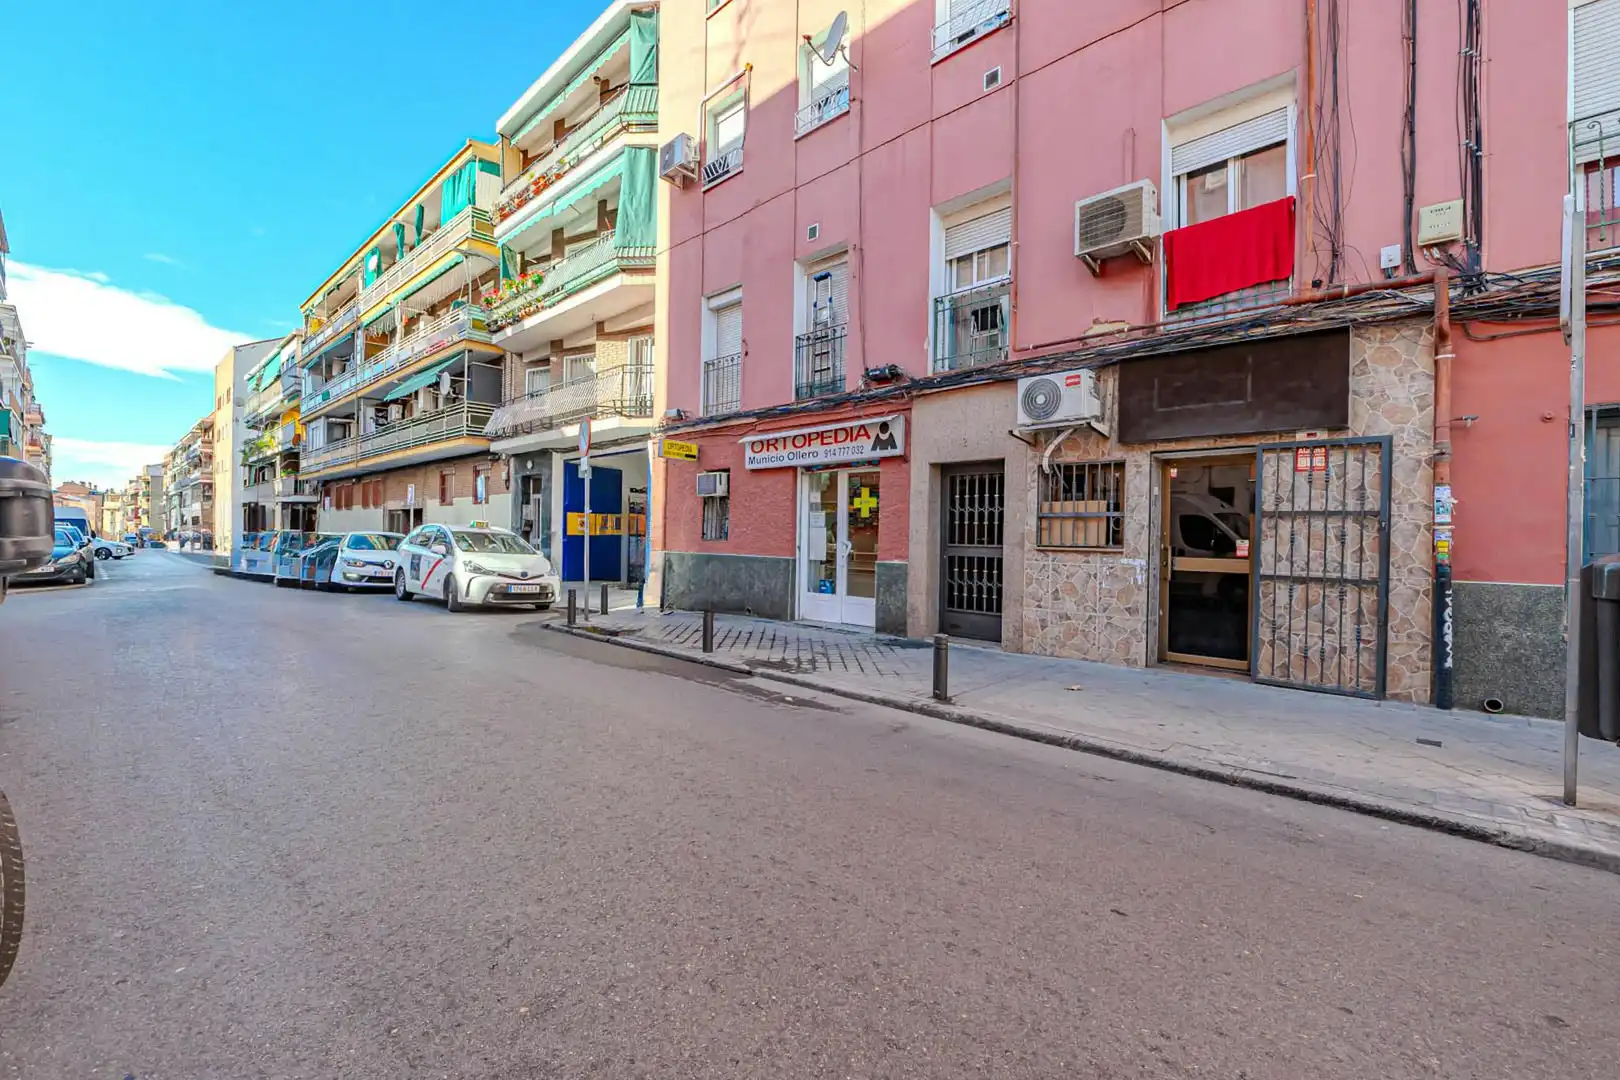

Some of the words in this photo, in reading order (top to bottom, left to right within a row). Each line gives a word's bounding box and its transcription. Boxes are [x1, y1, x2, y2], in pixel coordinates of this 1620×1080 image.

[750, 424, 871, 454] ORTOPEDIA
[748, 454, 785, 465] Municio
[787, 450, 819, 461] Ollero
[824, 449, 837, 459] 914
[838, 446, 850, 457] 777
